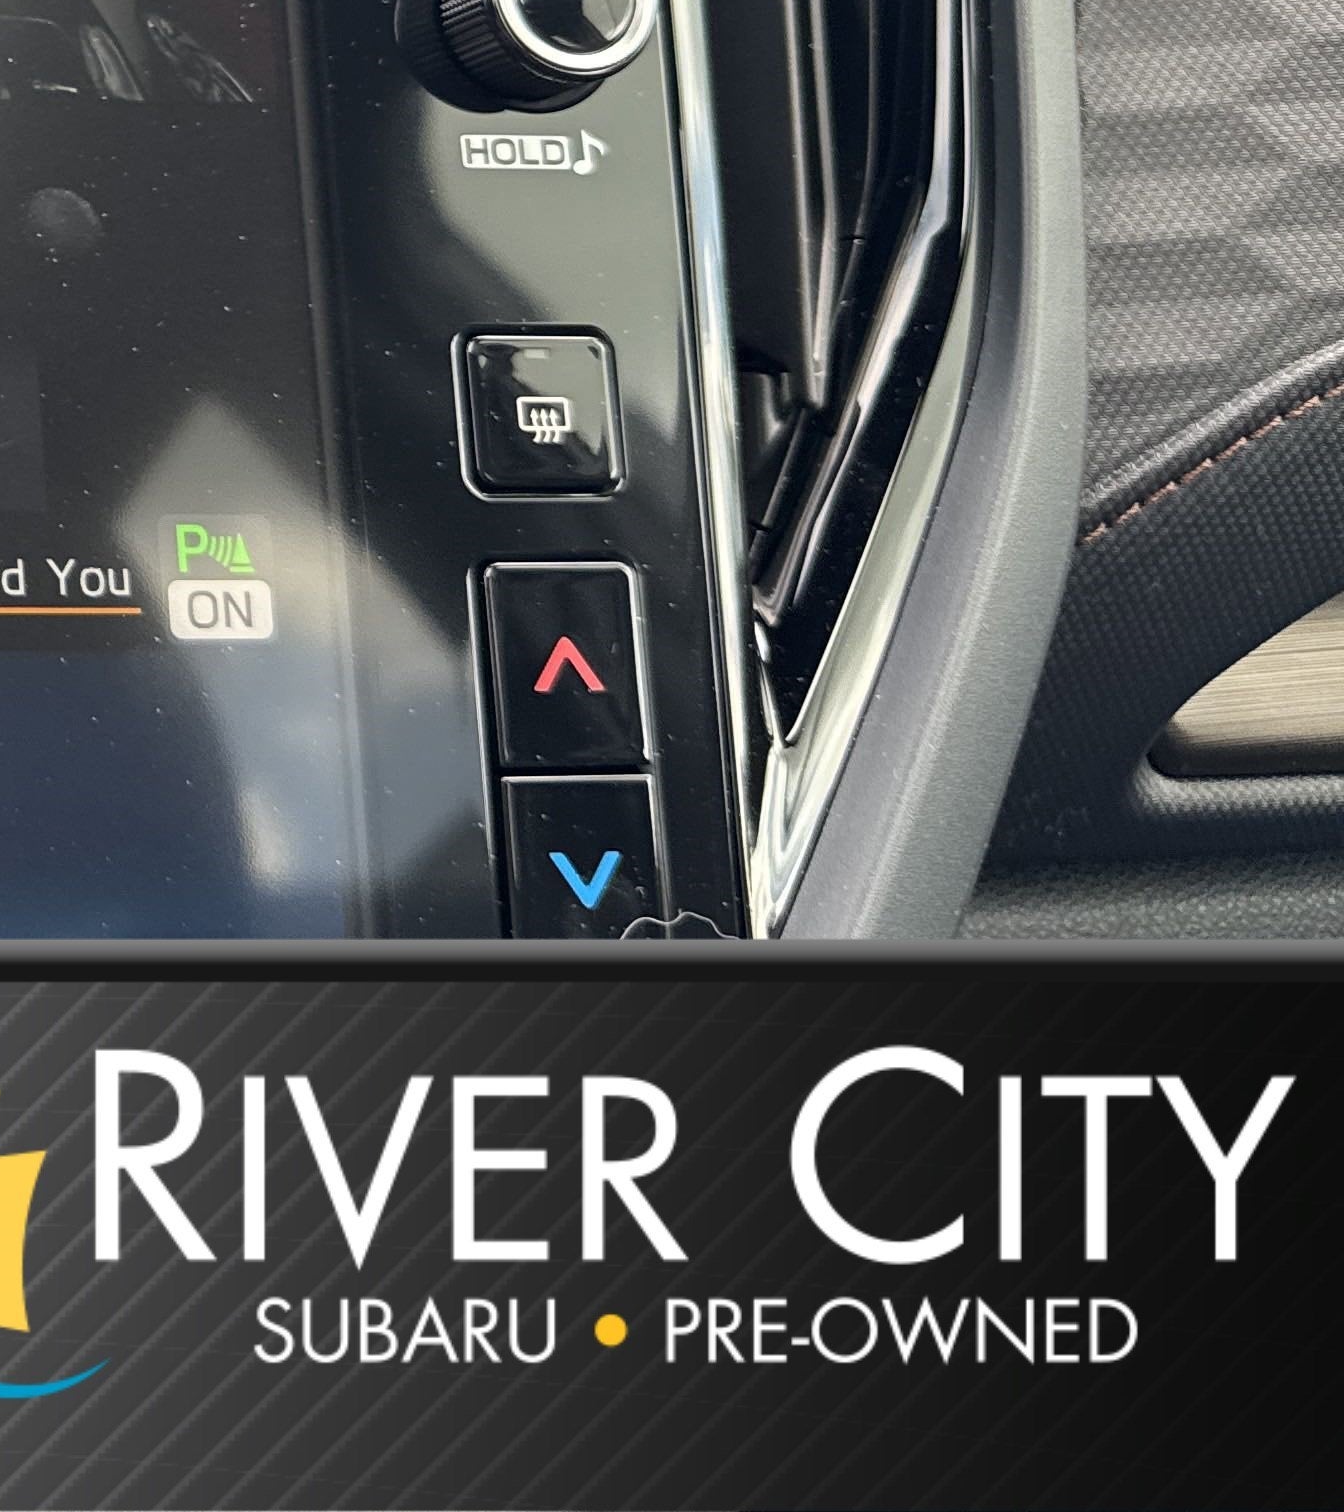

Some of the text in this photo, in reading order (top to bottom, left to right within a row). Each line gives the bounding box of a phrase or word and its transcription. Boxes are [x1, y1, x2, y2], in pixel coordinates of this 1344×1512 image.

[464, 138, 568, 166] HOLD
[46, 557, 131, 598] You
[186, 590, 255, 629] ON
